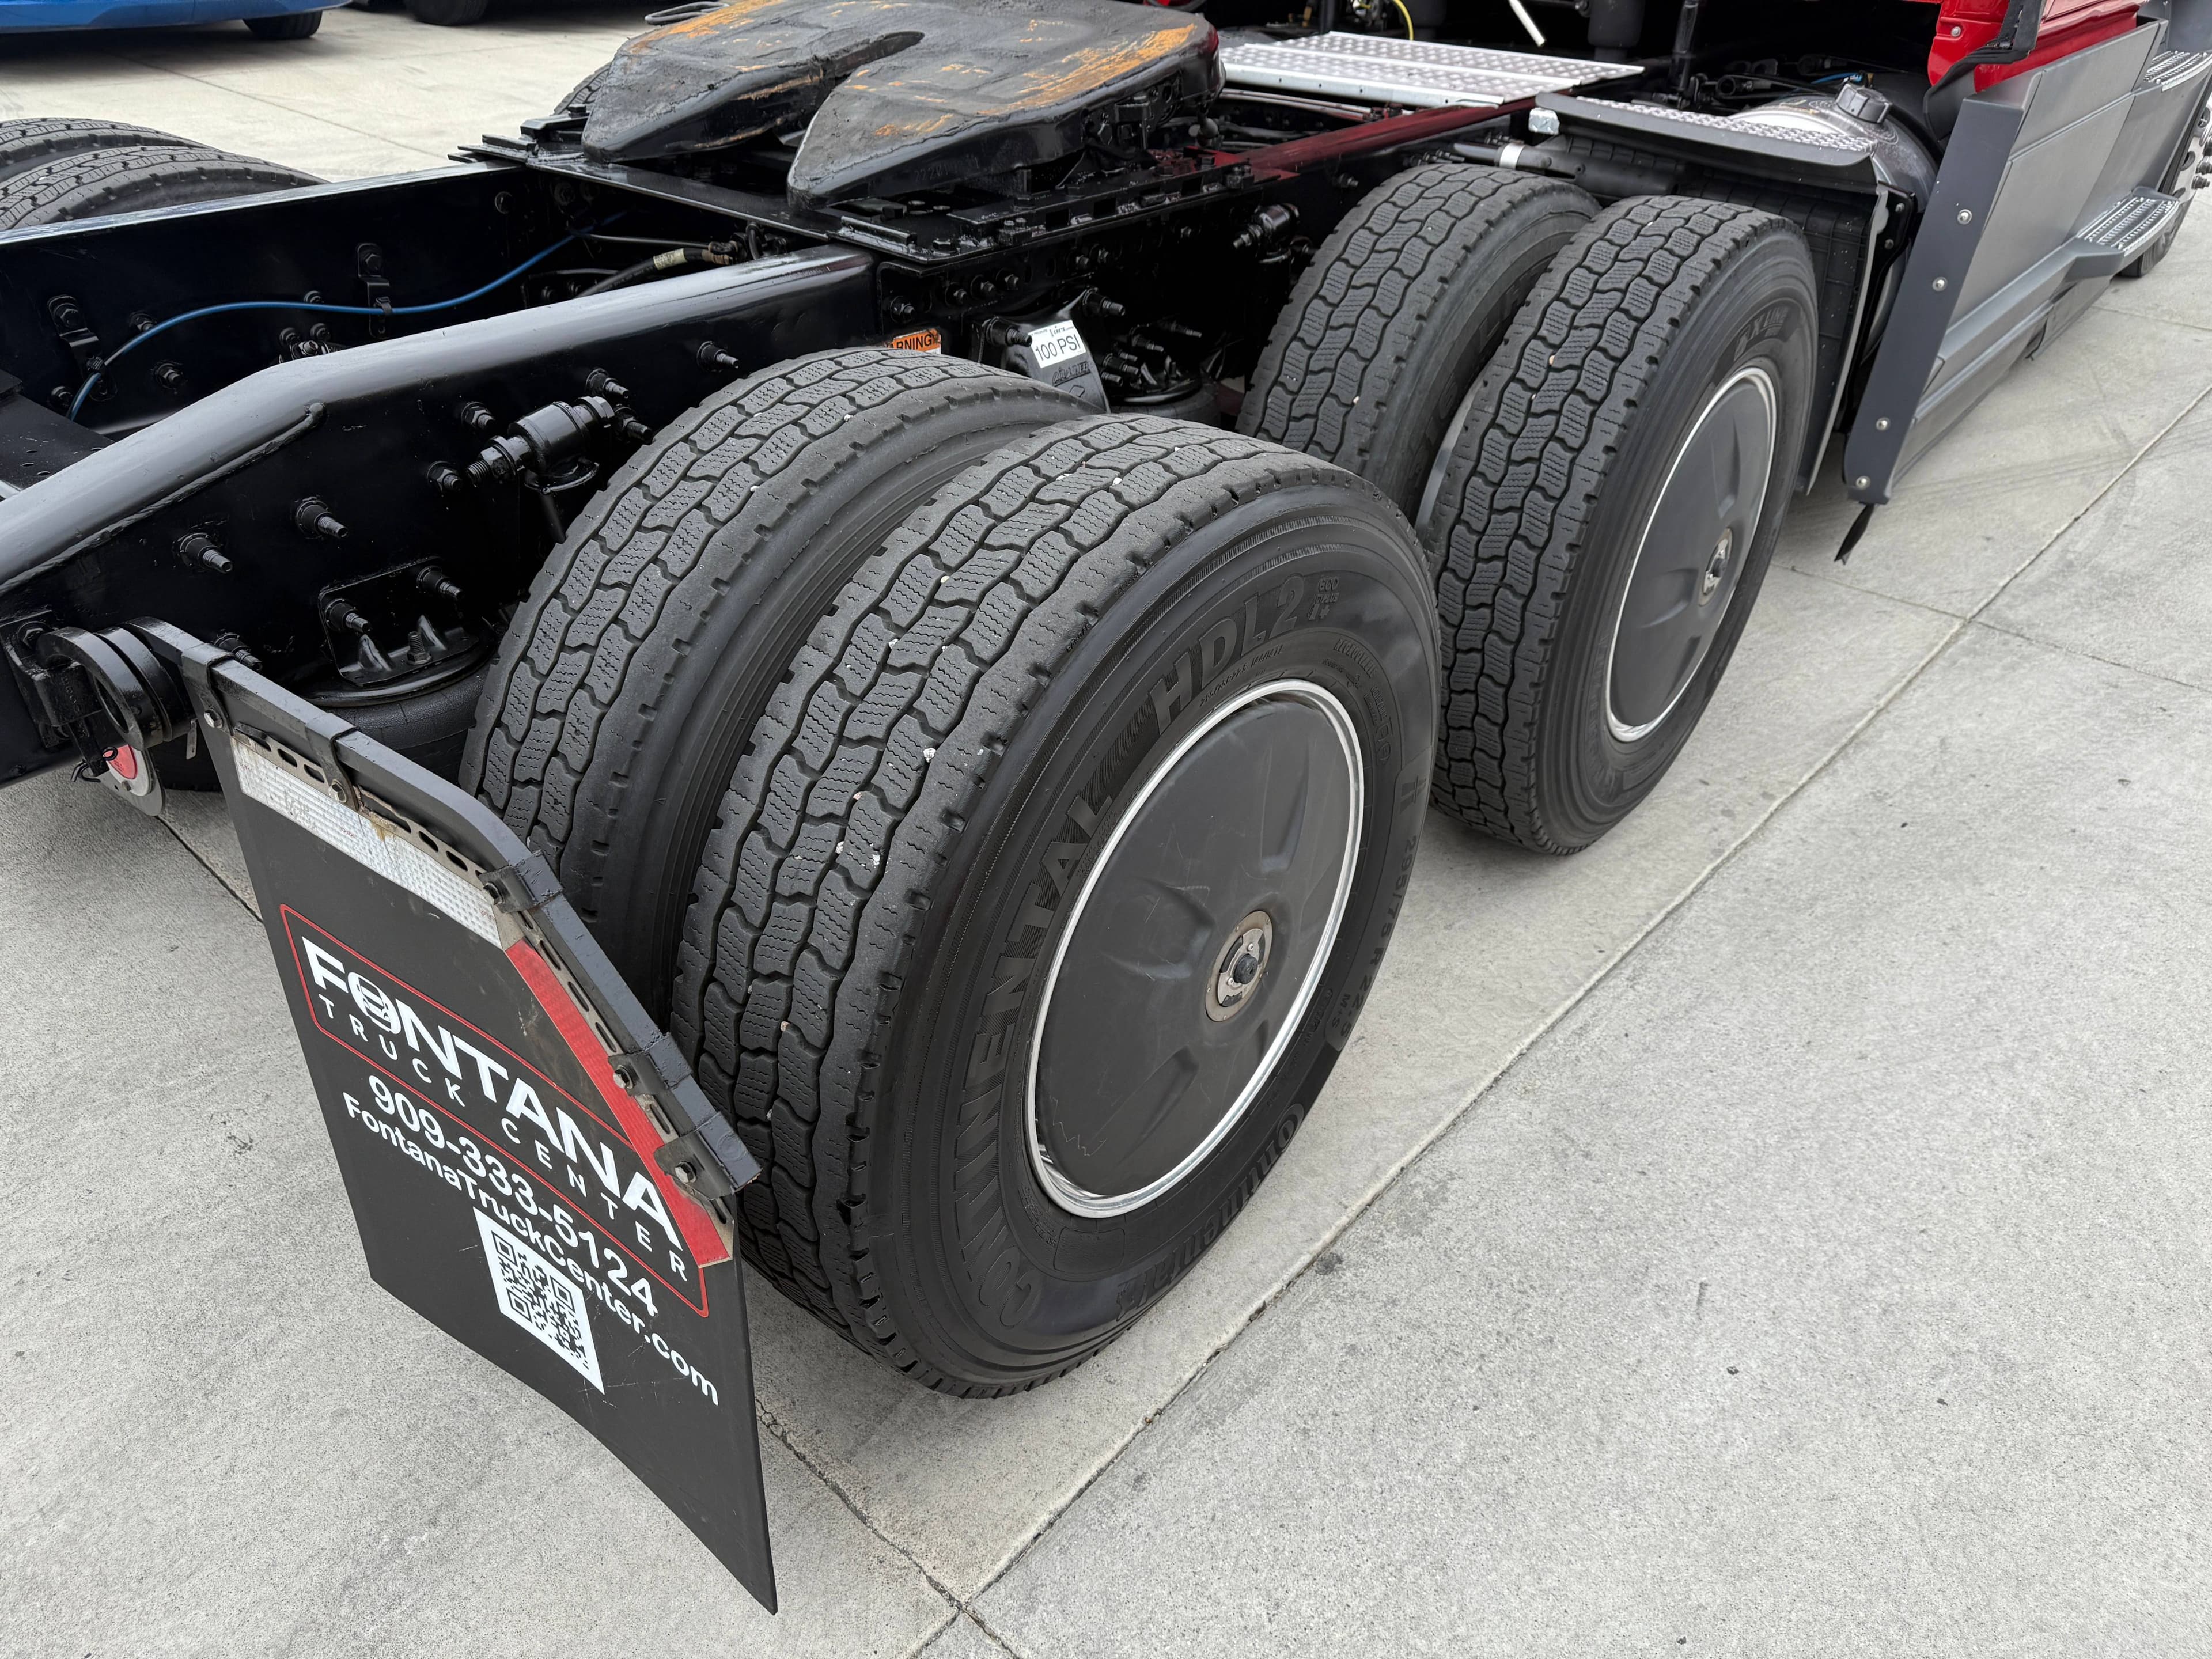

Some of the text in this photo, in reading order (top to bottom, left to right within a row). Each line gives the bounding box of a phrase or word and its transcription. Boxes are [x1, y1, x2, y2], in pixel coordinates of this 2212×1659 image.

[888, 334, 933, 350] RNING
[1036, 334, 1081, 361] 100 PSI
[1150, 575, 1305, 736] HDL2
[1340, 835, 1417, 1036] 295/75 R 22.5
[302, 936, 683, 1251] FONTANA
[319, 993, 688, 1281] TRUCK CENTER
[369, 1075, 658, 1317] 909-333-5124
[342, 1092, 719, 1406] FontanaTruckCenter.com
